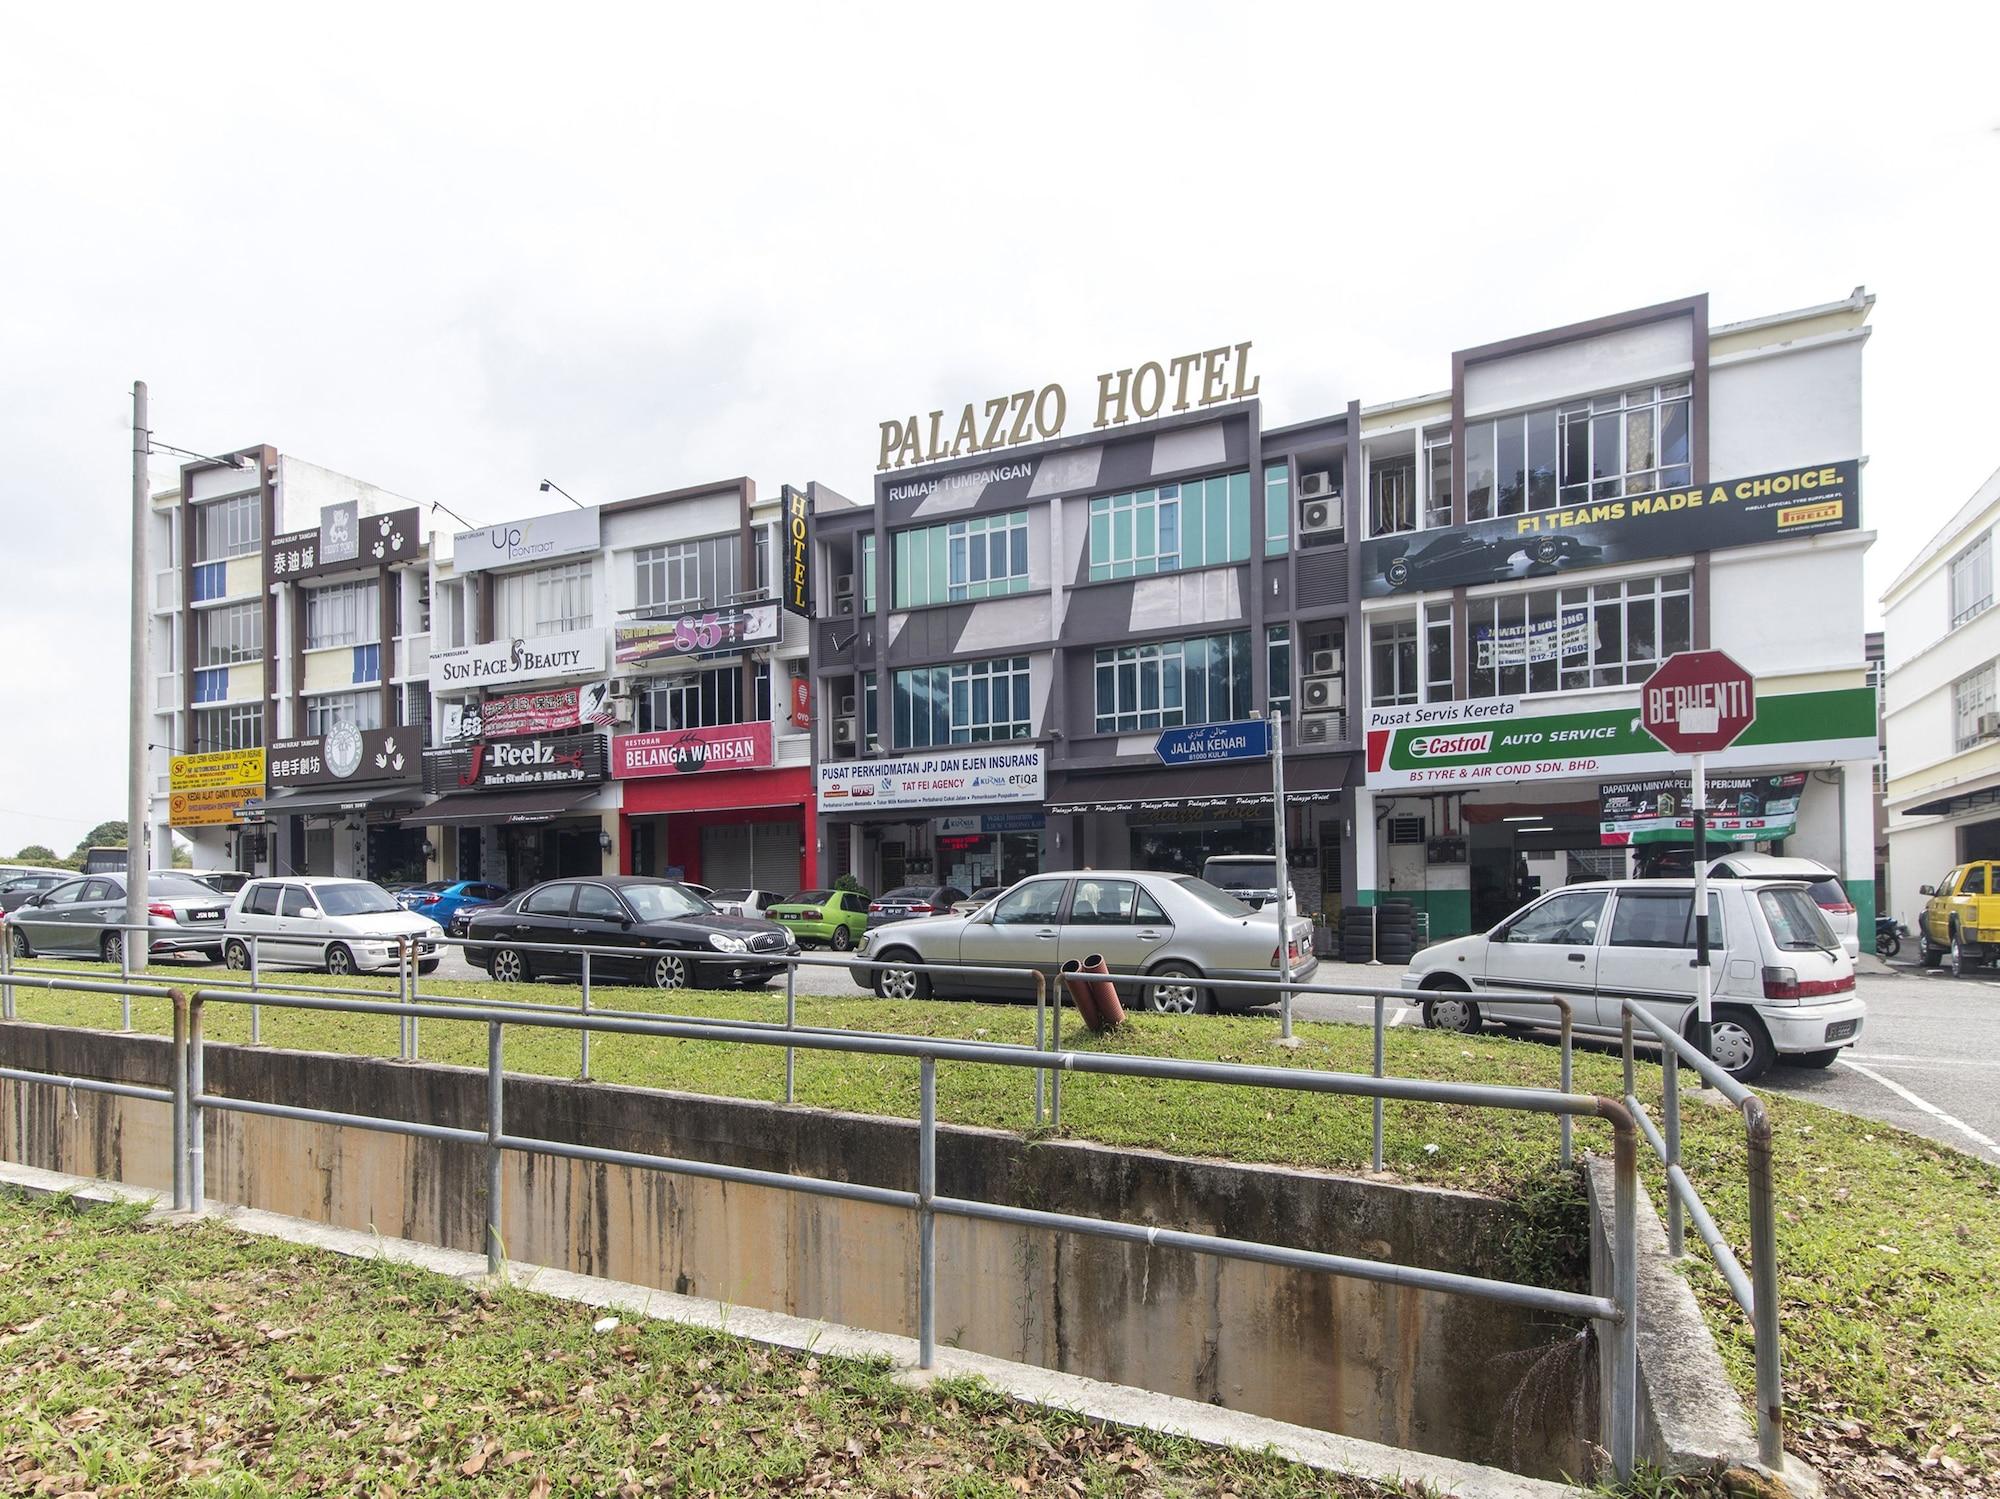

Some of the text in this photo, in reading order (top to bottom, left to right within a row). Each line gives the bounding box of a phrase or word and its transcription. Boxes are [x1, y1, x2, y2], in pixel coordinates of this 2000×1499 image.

[876, 341, 1260, 470] PALAZZO HOTEL
[889, 462, 1032, 502] RUMAH TUMPANGAN
[1517, 468, 1844, 535] F1 TEAMS MADE A CHOICE.
[1783, 505, 1836, 522] PIRELLI
[274, 546, 314, 574] 泰迪城
[791, 493, 806, 608] HOTEL
[674, 612, 722, 652] 85
[444, 650, 580, 680] SUN FACE BEAUTY
[1649, 680, 1748, 724] BERHENTI
[1372, 702, 1514, 726] Pusat Servis Kereta
[625, 738, 660, 747] RESTORAN
[1171, 736, 1246, 754] JALAN KENARI
[1429, 726, 1616, 754] Castrol AUTO SERVICE
[626, 740, 754, 767] BELANGA WARISAN
[1208, 751, 1228, 760] KULAI
[272, 756, 320, 778] 皂皂手創坊
[506, 772, 533, 784] Studio
[534, 772, 542, 781] &
[822, 754, 1038, 780] PUSAT PERKHIDMATAN JPJ DAN EJEN INSURANS
[1410, 760, 1600, 782] BS TYRE & AIR COND SDN. BHD.
[902, 782, 916, 790] TAT
[918, 781, 930, 790] FEI
[932, 779, 964, 789] AGENCY
[1602, 784, 1642, 794] DAPATKAN
[1643, 780, 1674, 791] MINYAK
[1286, 794, 1311, 802] Palazzo
[1637, 801, 1648, 814] 3
[1718, 798, 1728, 812] 4
[1052, 806, 1072, 814] Palazzo
